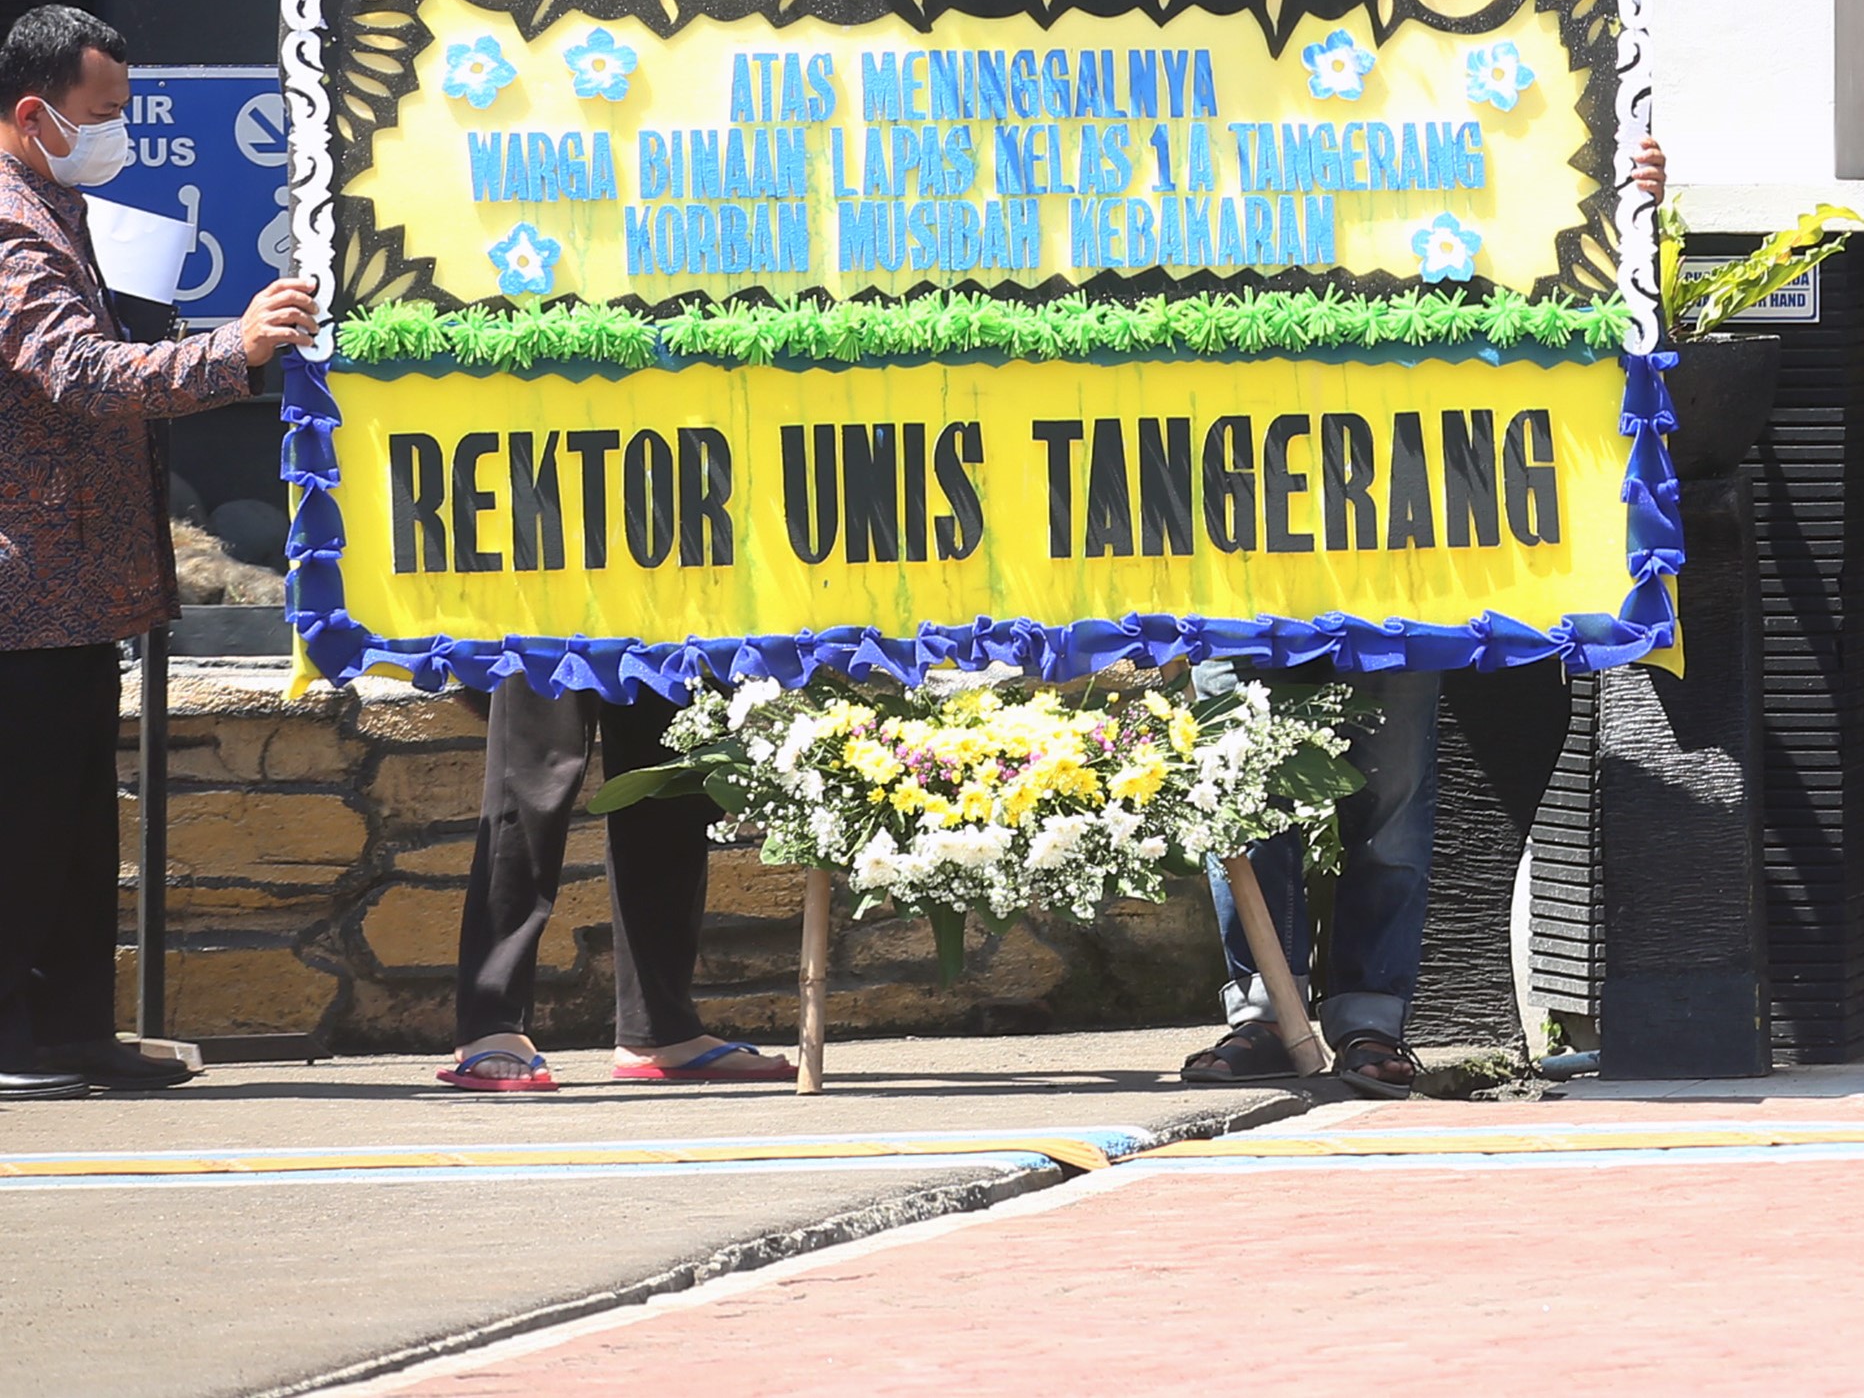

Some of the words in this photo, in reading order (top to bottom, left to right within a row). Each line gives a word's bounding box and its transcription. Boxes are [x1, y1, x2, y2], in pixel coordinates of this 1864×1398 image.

[729, 51, 835, 124] ATAS
[862, 48, 1218, 122] MENINGGALNYA
[467, 130, 618, 202] WARGA
[637, 127, 808, 200] BINAAN
[829, 124, 977, 197] LAPAS
[994, 123, 1133, 196] KELAS
[1228, 120, 1485, 192] TANGERANG
[624, 202, 810, 276] KORBAN
[837, 198, 1041, 272] MUSIBAH
[1071, 194, 1336, 269] KEBAKARAN
[1770, 293, 1806, 307] HAND
[388, 427, 734, 575] REKTOR
[780, 421, 985, 565] UNIS
[1031, 409, 1562, 559] TANGERANG
